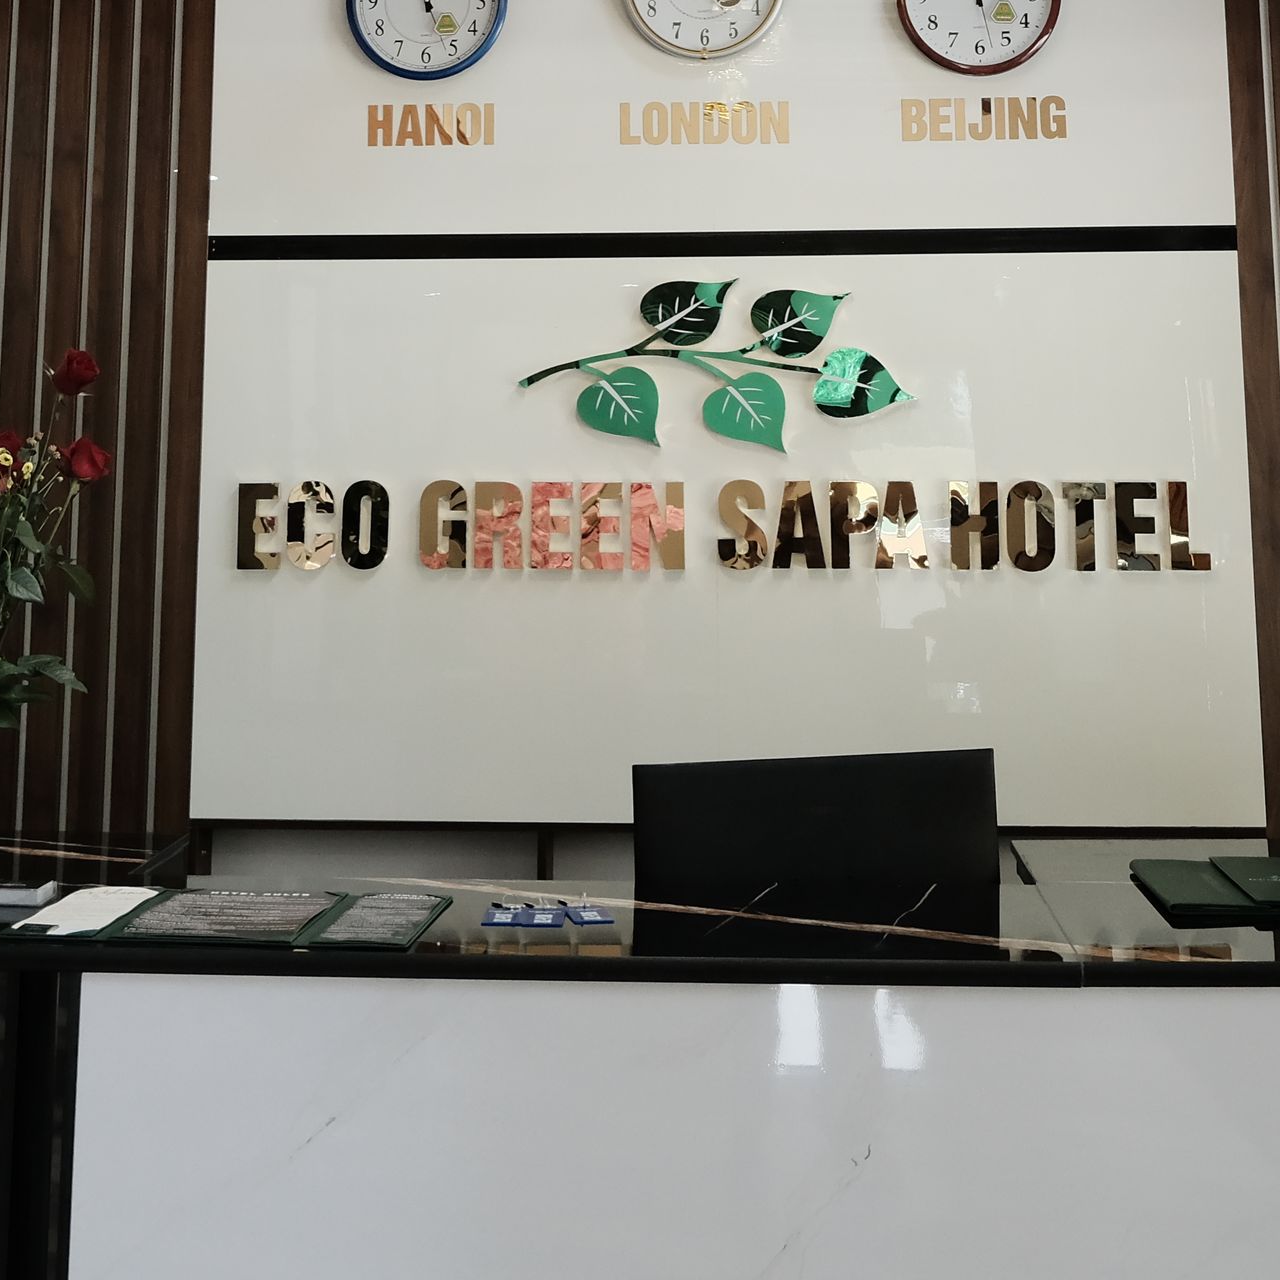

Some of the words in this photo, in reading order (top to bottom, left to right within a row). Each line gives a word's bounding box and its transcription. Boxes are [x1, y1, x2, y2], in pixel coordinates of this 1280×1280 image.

[647, 0, 657, 17] 8
[375, 19, 385, 36] 8
[467, 19, 478, 36] 4
[927, 14, 938, 30] 8
[1019, 13, 1030, 29] 4
[672, 22, 682, 39] 7
[700, 28, 710, 46] 6
[728, 22, 739, 39] 5
[1000, 31, 1011, 46] 5
[394, 40, 404, 57] 7
[448, 39, 458, 56] 5
[948, 32, 959, 48] 7
[975, 39, 986, 55] 6
[421, 46, 431, 64] 6
[367, 103, 495, 146] HANOI
[620, 101, 790, 145] LONDON
[900, 95, 1067, 141] BEIJING
[237, 480, 390, 570] ECO
[420, 480, 685, 571] GREEN
[717, 480, 930, 571] SAPA
[949, 480, 1211, 572] HOTEL
